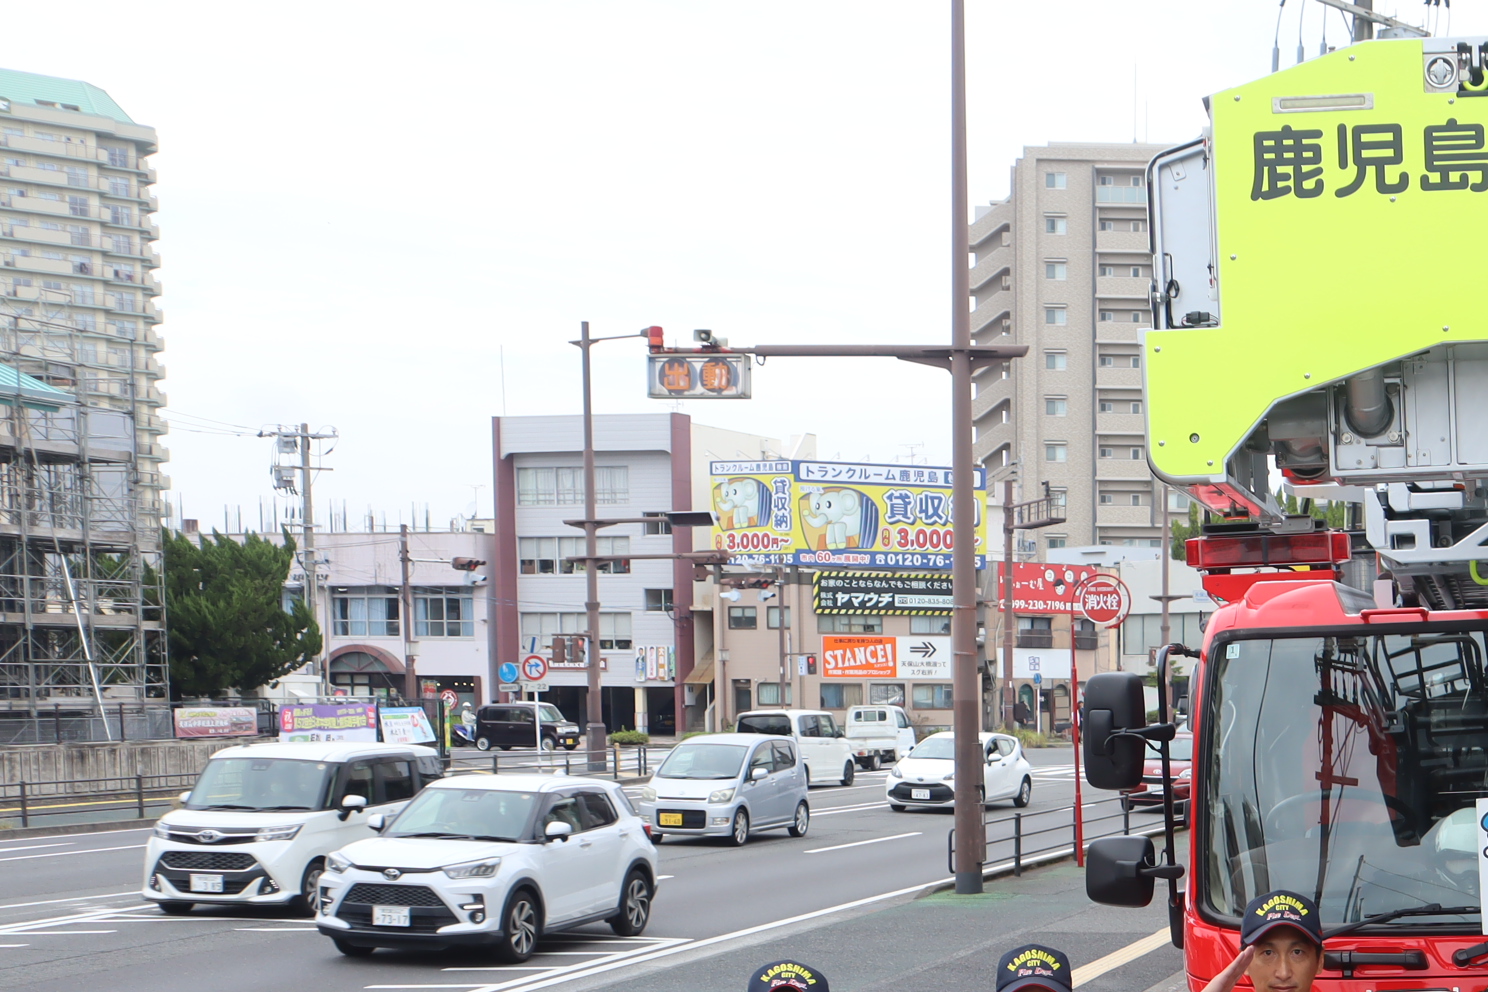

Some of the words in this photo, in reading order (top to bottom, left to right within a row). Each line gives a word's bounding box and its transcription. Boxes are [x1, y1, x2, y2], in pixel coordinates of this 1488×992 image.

[773, 479, 788, 529] 貸収納
[836, 592, 893, 607] ヤマウチ
[1085, 593, 1119, 610] 消火栓
[825, 643, 894, 669] STANCE!
[1255, 895, 1309, 916] KAGOSHIMA
[1006, 949, 1061, 972] KAGOSHIMA
[760, 963, 816, 985] KAGOSHIMA
